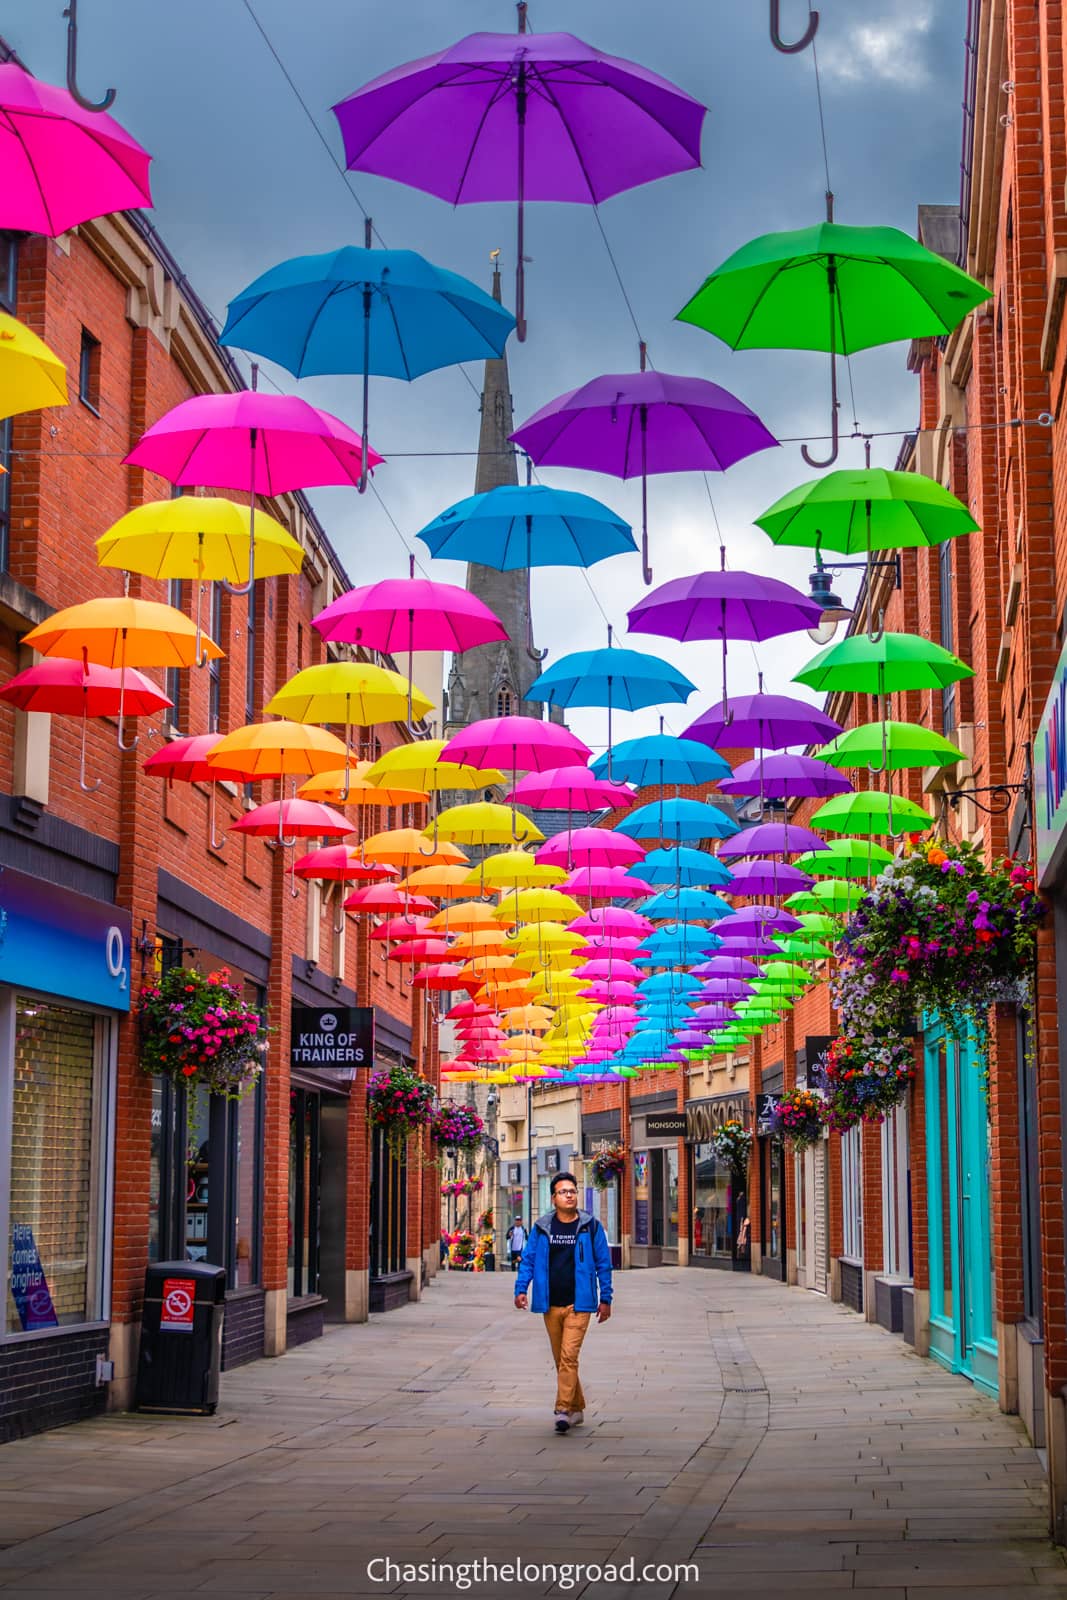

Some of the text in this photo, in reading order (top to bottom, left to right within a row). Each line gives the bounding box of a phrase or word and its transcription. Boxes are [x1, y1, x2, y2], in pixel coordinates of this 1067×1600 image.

[300, 1033, 357, 1046] KING OF
[292, 1048, 364, 1062] TRAINERS
[648, 1121, 685, 1129] MONSOON
[686, 1099, 744, 1140] MONSOON
[13, 1224, 31, 1241] Here
[12, 1249, 36, 1265] comes
